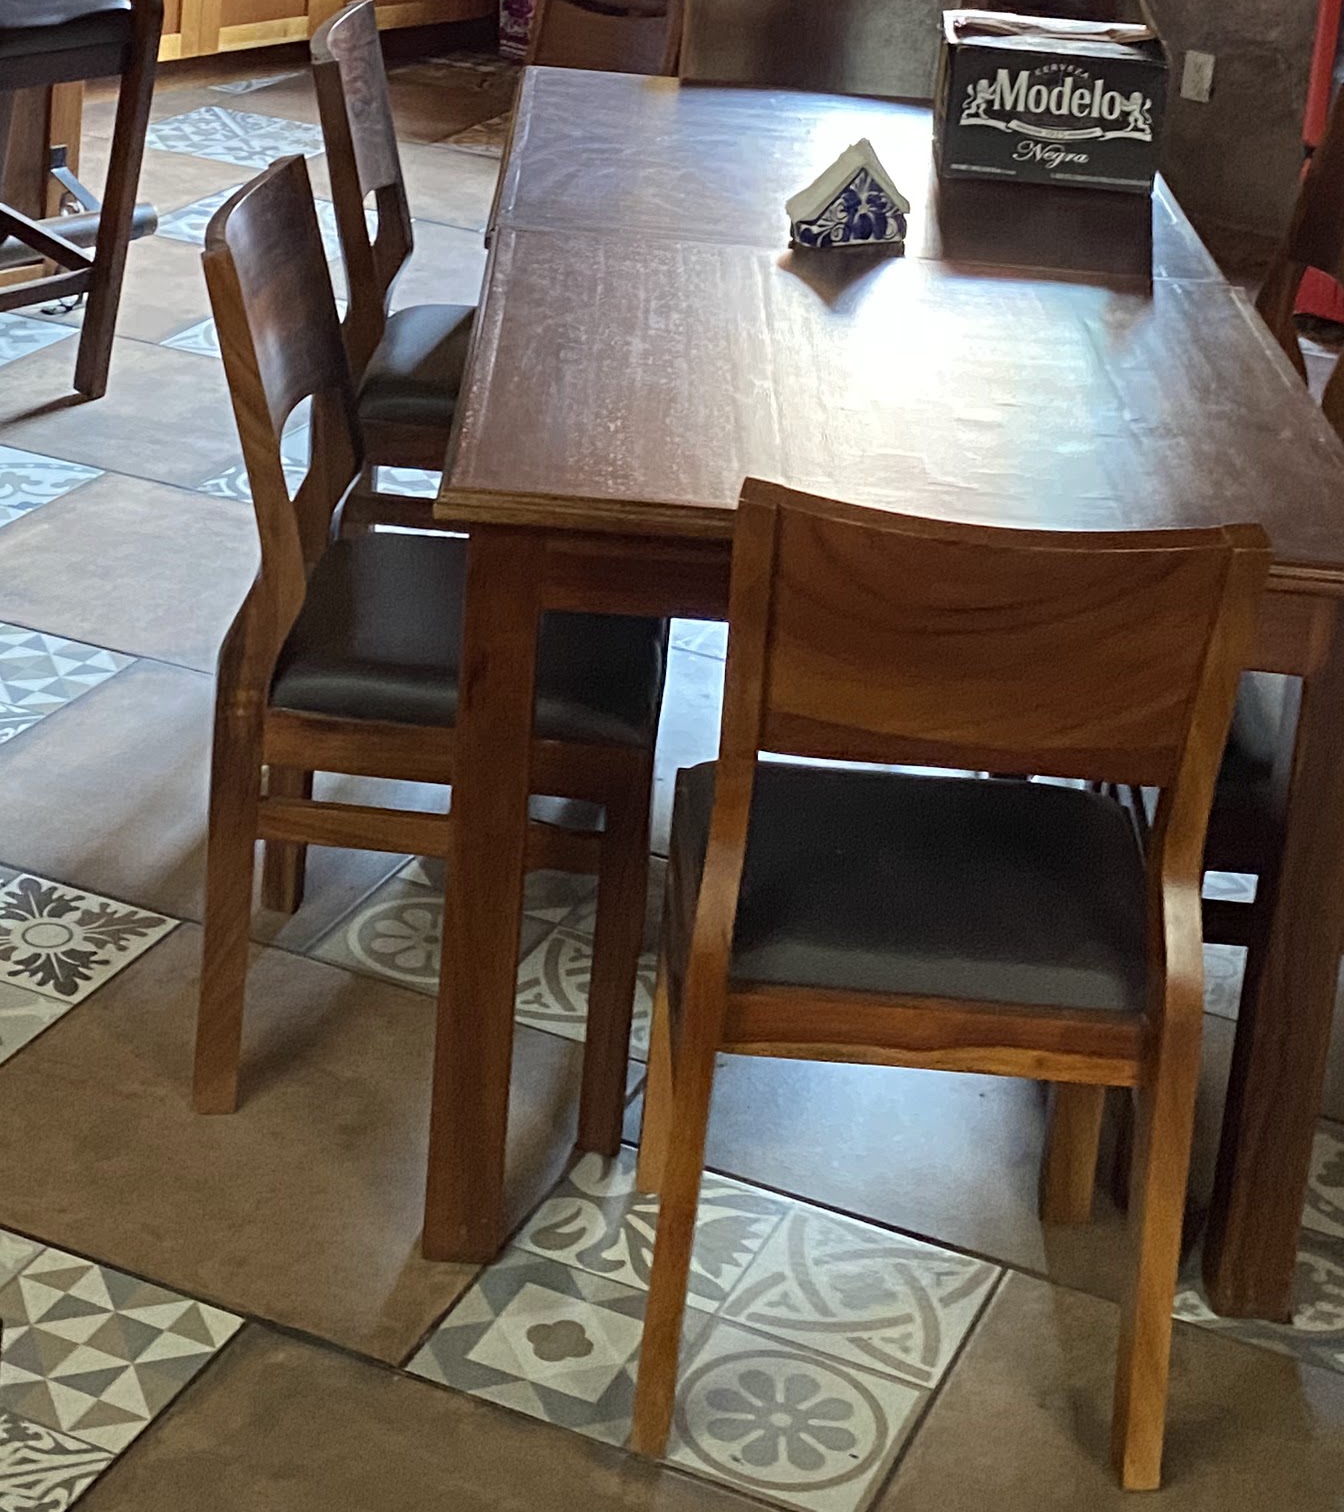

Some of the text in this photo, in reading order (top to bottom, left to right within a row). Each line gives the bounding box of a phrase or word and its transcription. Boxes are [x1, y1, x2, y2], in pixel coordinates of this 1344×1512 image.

[1034, 63, 1089, 79] CERVEZA
[992, 68, 1122, 120] Modelo
[1012, 140, 1089, 169] Negra
